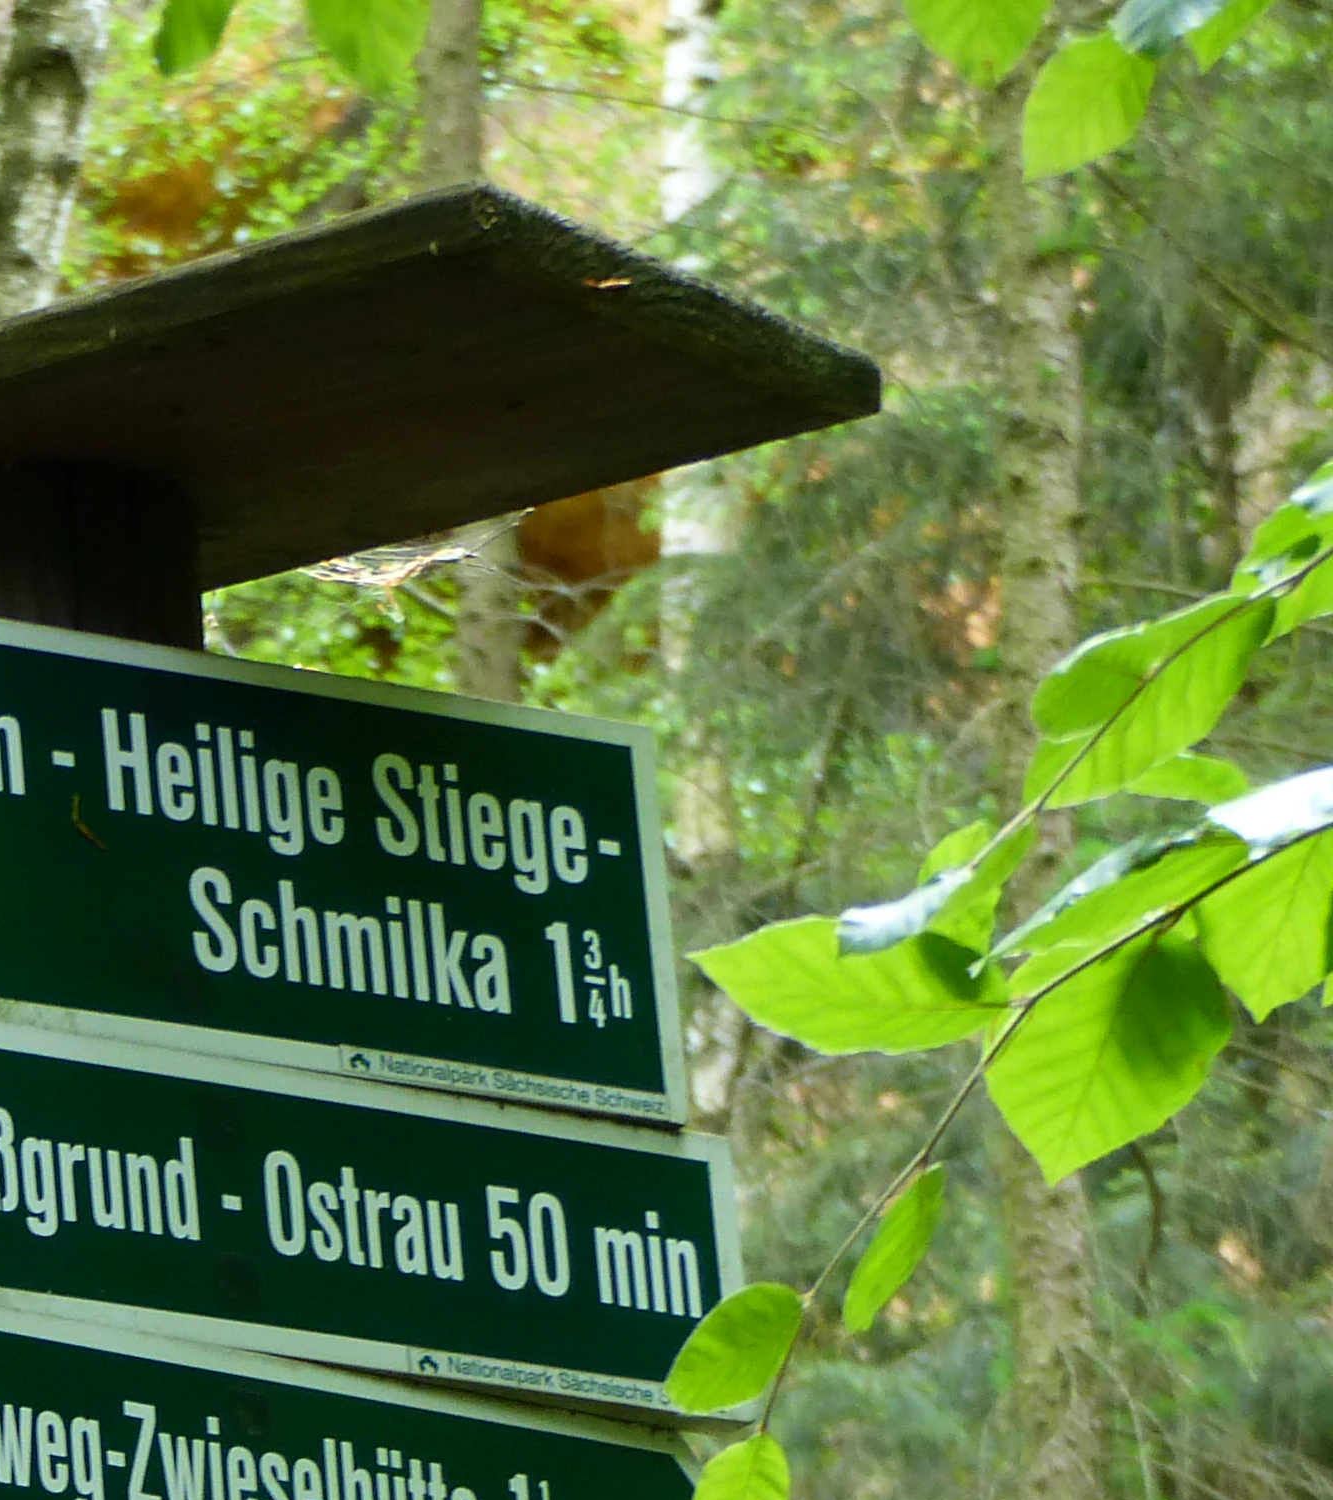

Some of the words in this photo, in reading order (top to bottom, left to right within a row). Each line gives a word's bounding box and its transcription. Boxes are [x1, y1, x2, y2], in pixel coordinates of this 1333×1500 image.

[100, 707, 345, 857] Heilige
[371, 751, 621, 896] Stiege-
[188, 866, 512, 1016] Schmilka
[380, 1054, 489, 1088] Nationalpark
[493, 1071, 591, 1104] Sächsische
[595, 1088, 667, 1115] Schweiz
[262, 1149, 464, 1282] Ostrau
[485, 1184, 571, 1299] 50
[593, 1210, 703, 1319] min
[447, 1355, 555, 1387] Nationalpark
[558, 1371, 654, 1403] Sächsische
